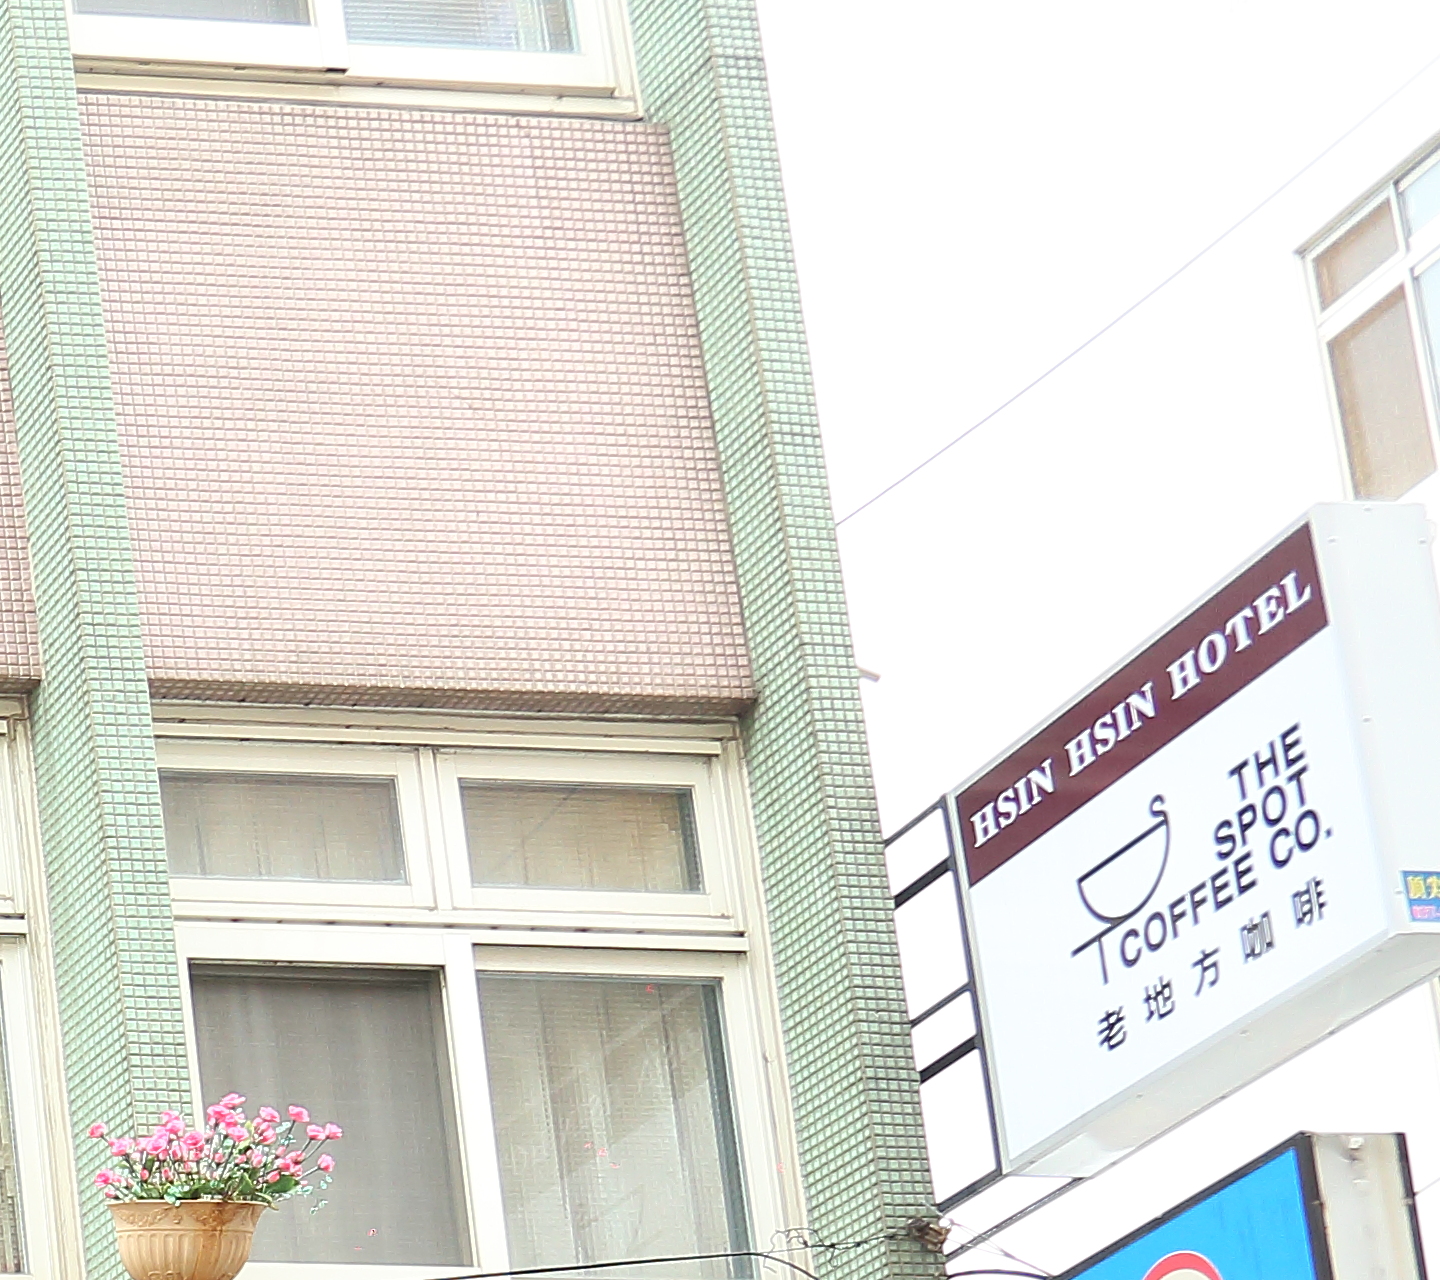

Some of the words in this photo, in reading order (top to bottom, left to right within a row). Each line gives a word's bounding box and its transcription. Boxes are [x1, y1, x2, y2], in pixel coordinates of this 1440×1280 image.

[969, 759, 1057, 848] HSIN
[1064, 683, 1157, 777] HSIN
[1167, 570, 1312, 699] HOTEL
[1229, 722, 1309, 800] THE
[1120, 852, 1257, 968] COFFEE
[1269, 810, 1333, 869] CO.
[1214, 765, 1311, 861] SPOT
[1098, 876, 1329, 1051] 老地方咖啡
